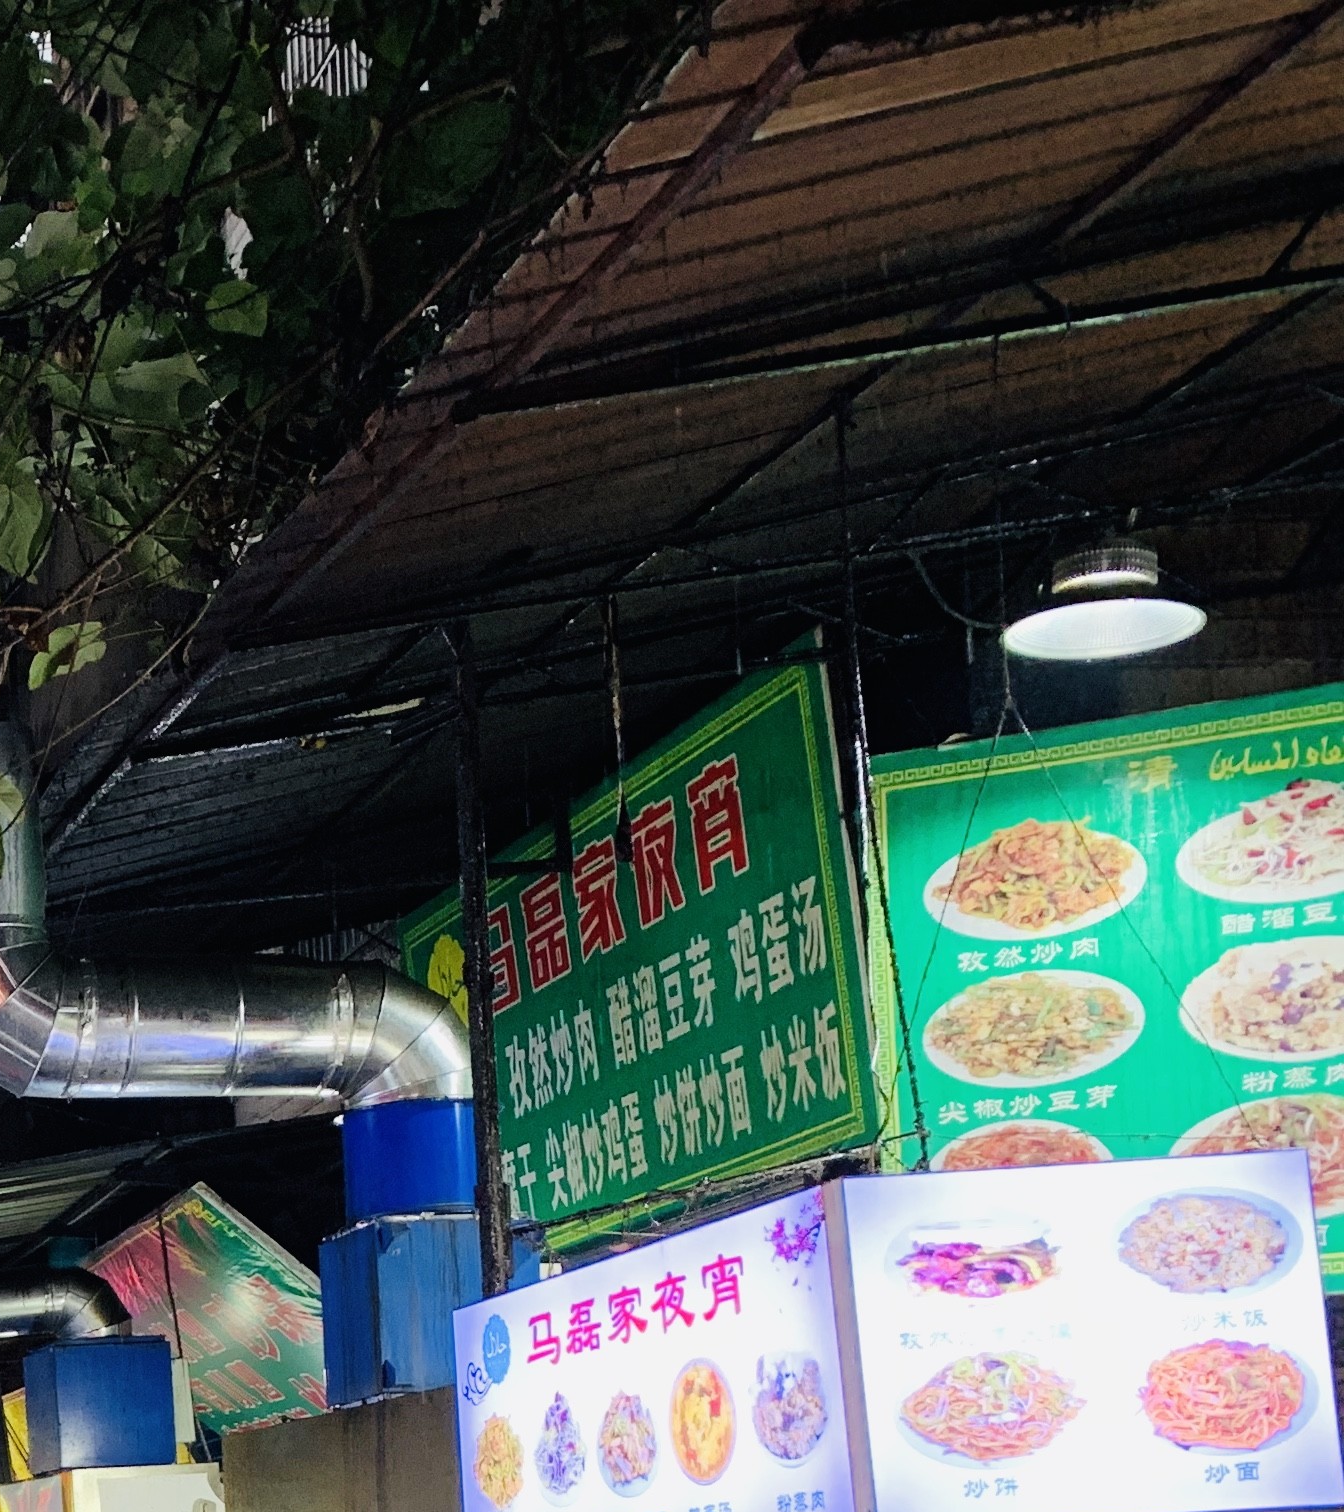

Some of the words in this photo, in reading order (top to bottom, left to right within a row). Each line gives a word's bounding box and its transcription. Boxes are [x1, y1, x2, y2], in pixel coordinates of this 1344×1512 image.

[727, 875, 828, 1004] 鸡蛋汤
[957, 935, 1101, 974] 孜然炒肉
[759, 1001, 848, 1123] 炒米饭
[525, 1254, 745, 1366] 马磊家夜宵
[1204, 1461, 1261, 1484] 炒面
